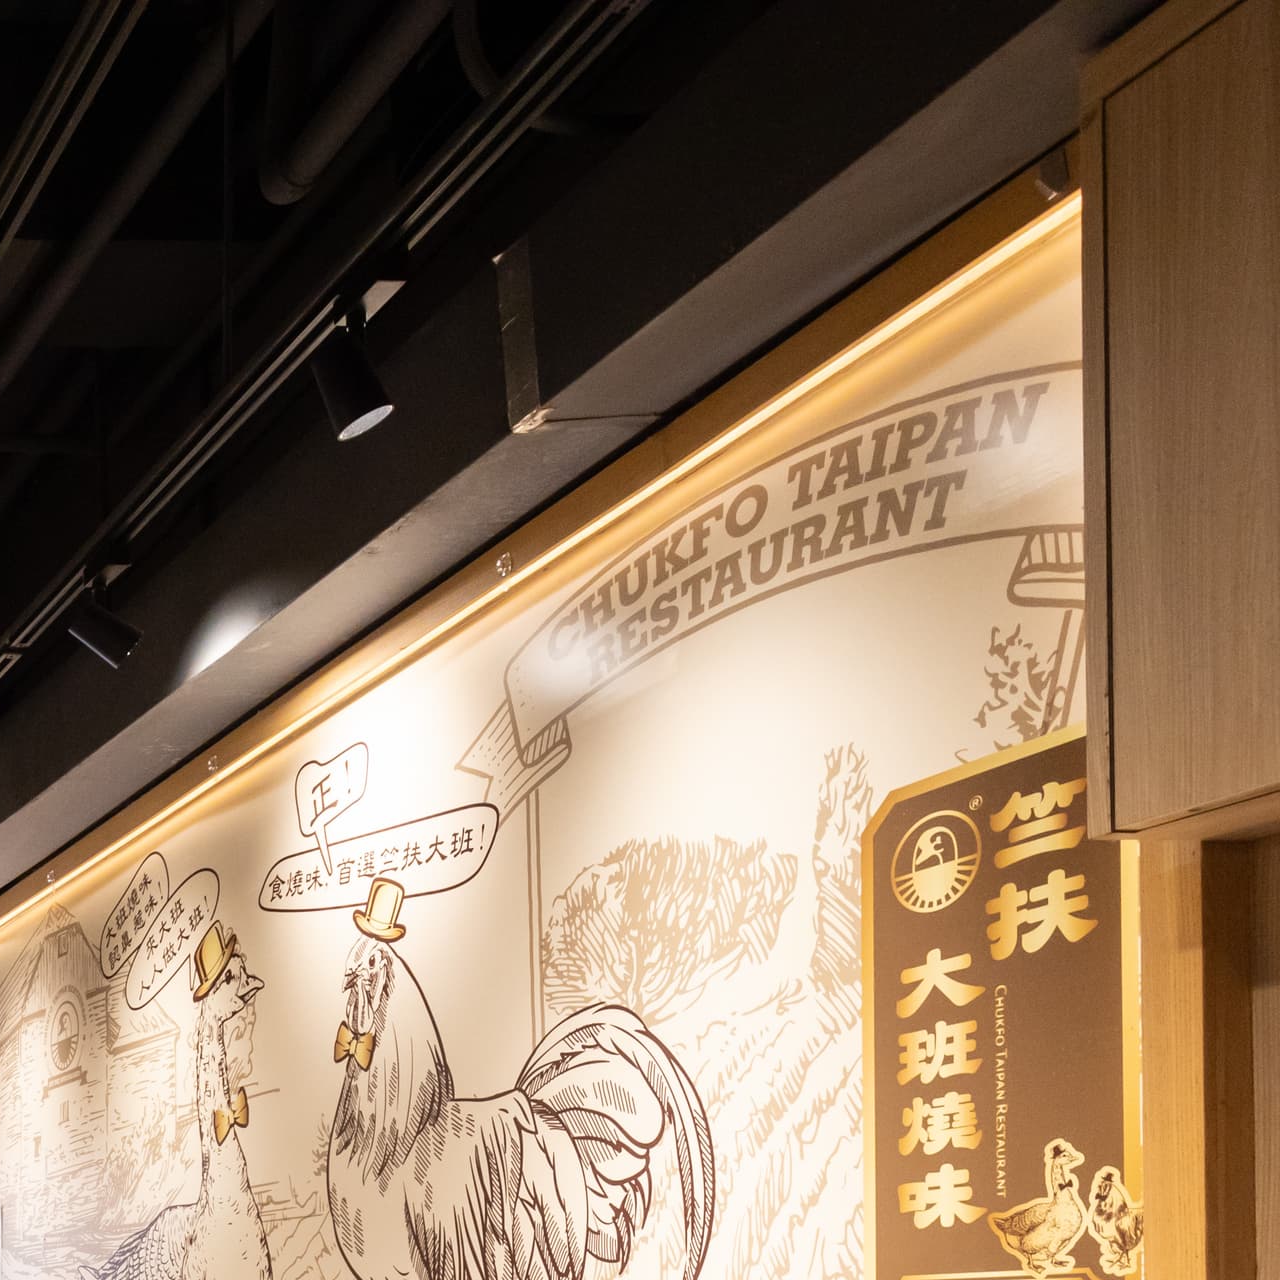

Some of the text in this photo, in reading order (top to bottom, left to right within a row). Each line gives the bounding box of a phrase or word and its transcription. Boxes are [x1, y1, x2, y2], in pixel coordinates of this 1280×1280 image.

[547, 381, 1050, 661] CHUKFO TAIPAN
[587, 468, 968, 685] RESTAURANT
[985, 777, 1099, 961] 竺扶
[896, 947, 989, 1230] 大班燒味
[995, 1048, 1009, 1100] TAIPAN
[995, 1103, 1009, 1200] RESTAURANT
